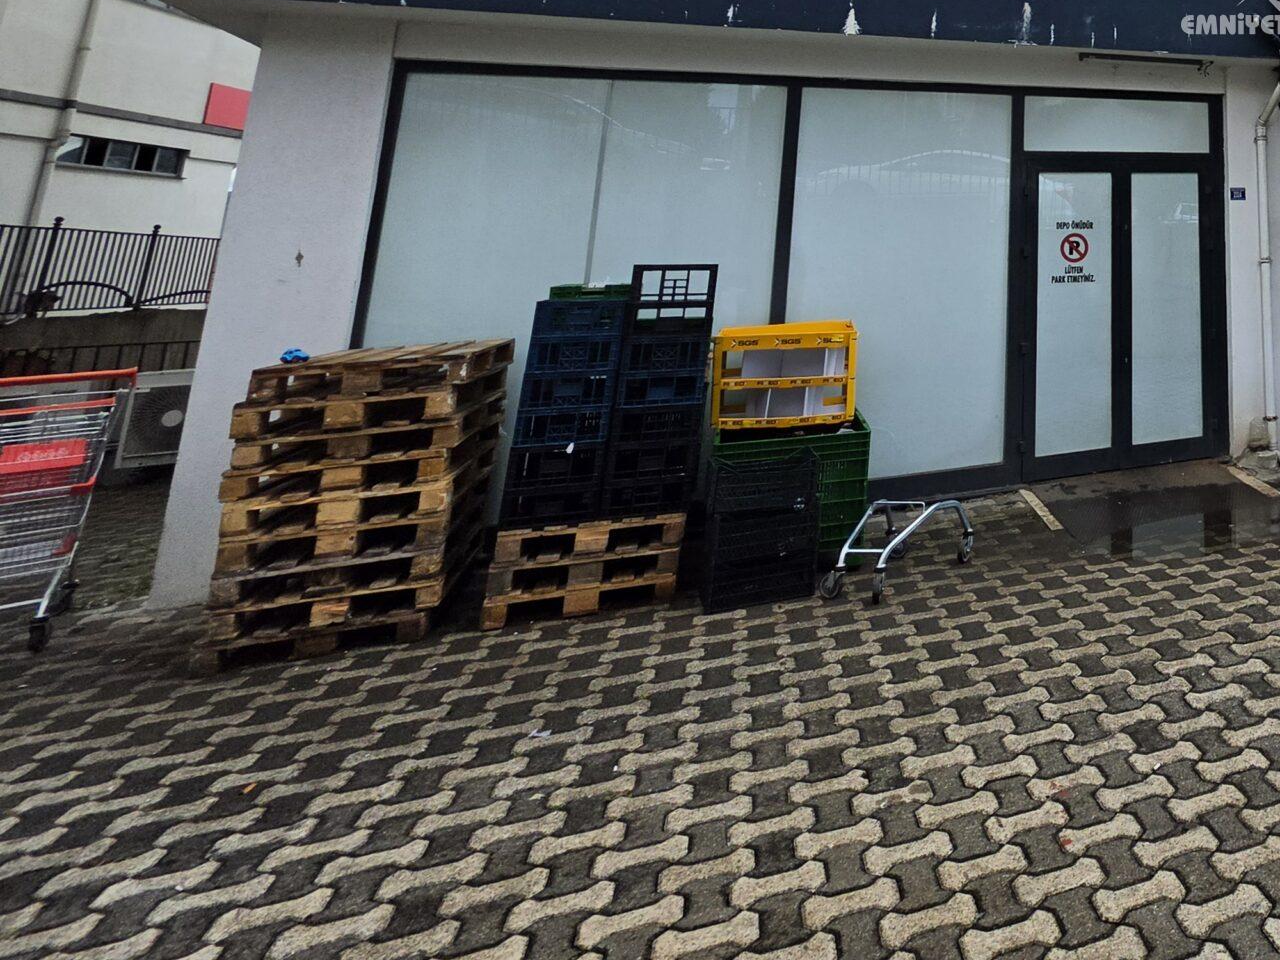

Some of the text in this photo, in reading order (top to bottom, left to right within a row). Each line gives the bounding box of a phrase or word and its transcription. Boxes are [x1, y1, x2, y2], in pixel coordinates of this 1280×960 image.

[1056, 221, 1070, 230] DEPO
[1064, 265, 1084, 274] LÜTFEN
[1051, 275, 1066, 284] PARK
